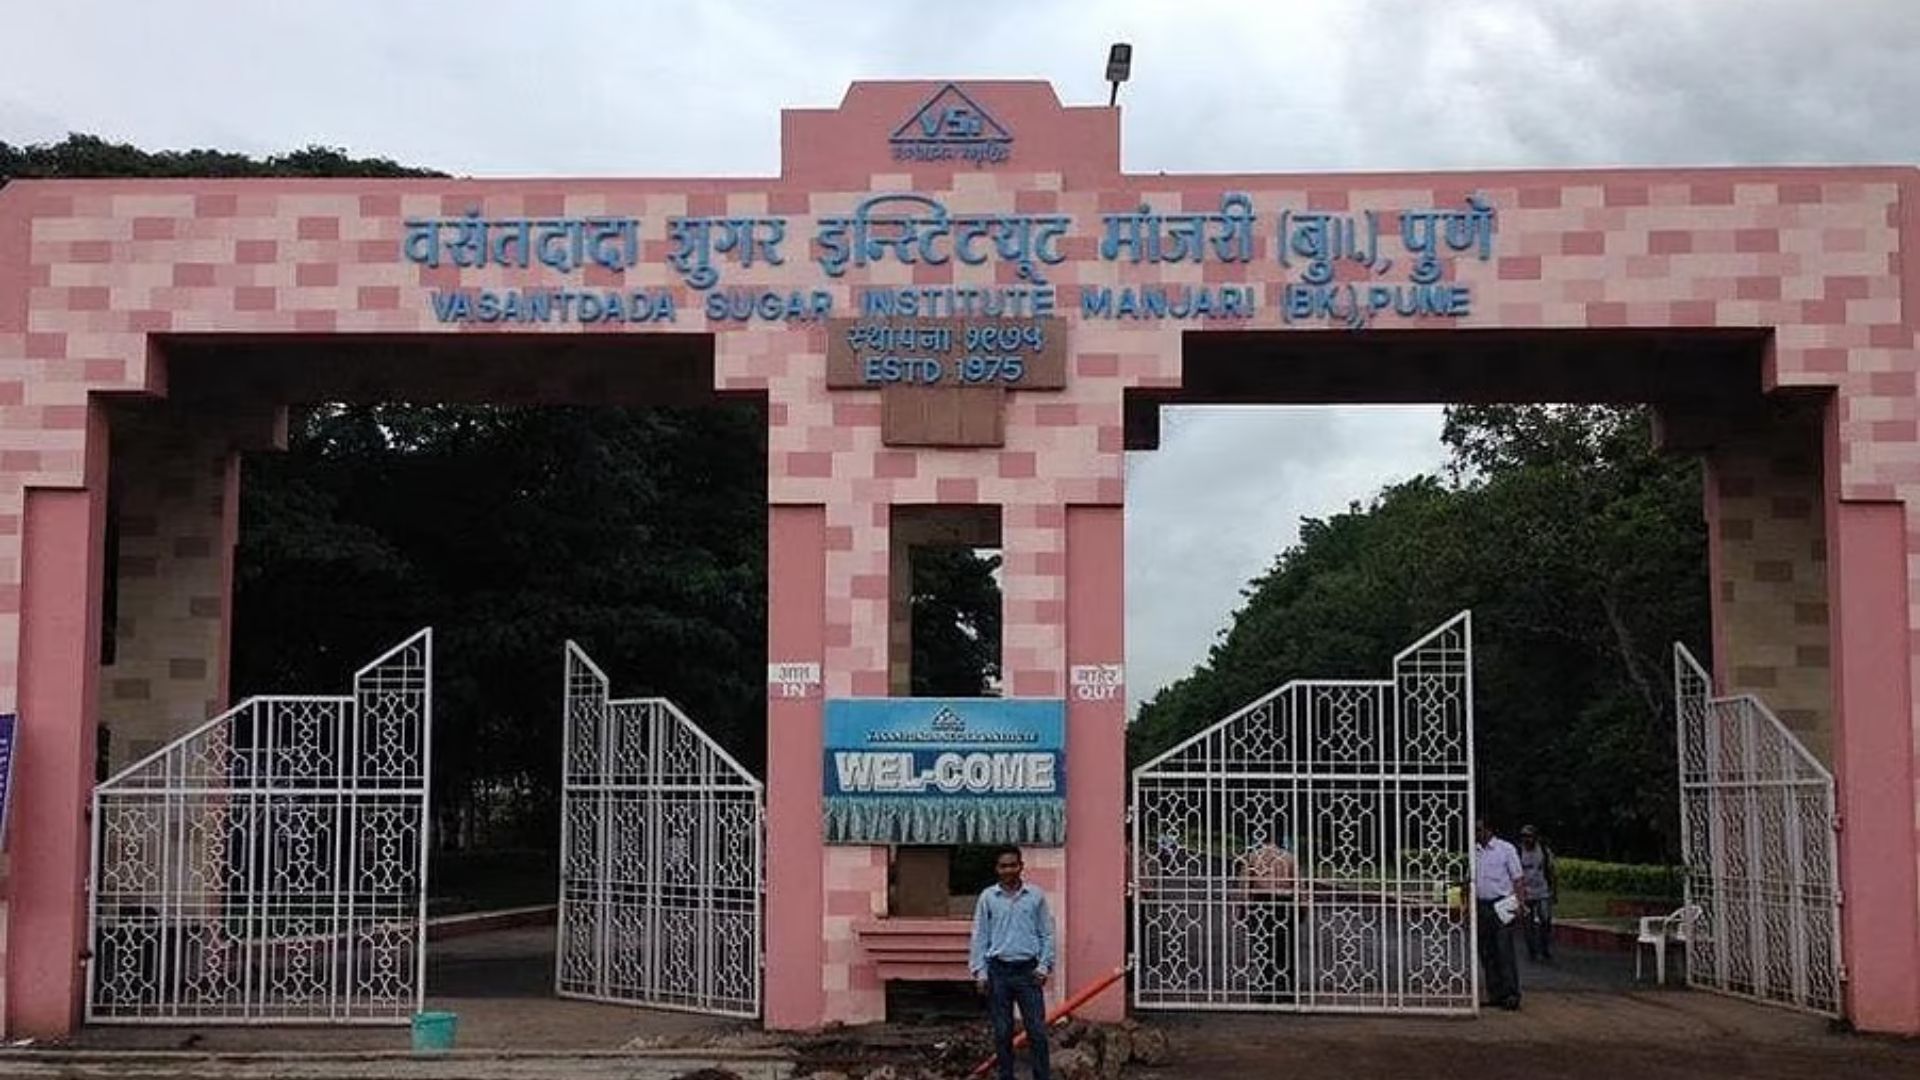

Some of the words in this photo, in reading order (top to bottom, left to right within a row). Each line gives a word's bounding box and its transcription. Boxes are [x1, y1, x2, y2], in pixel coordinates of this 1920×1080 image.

[405, 207, 639, 272] वसंतदादा
[667, 215, 788, 290] शुगर
[1102, 193, 1254, 263] मांजरी
[432, 289, 677, 323] VASANTDADA
[707, 288, 833, 321] SUGAR
[862, 287, 1056, 319] INSTITUTE
[1080, 286, 1256, 319] MANJARI
[848, 326, 951, 353] स्थापना
[965, 325, 1045, 353] १९७५
[865, 355, 943, 384] ESTD
[955, 355, 1025, 383] 1975
[782, 684, 806, 698] IN
[1078, 686, 1116, 700] OUT
[835, 752, 1056, 793] WEL-COME
